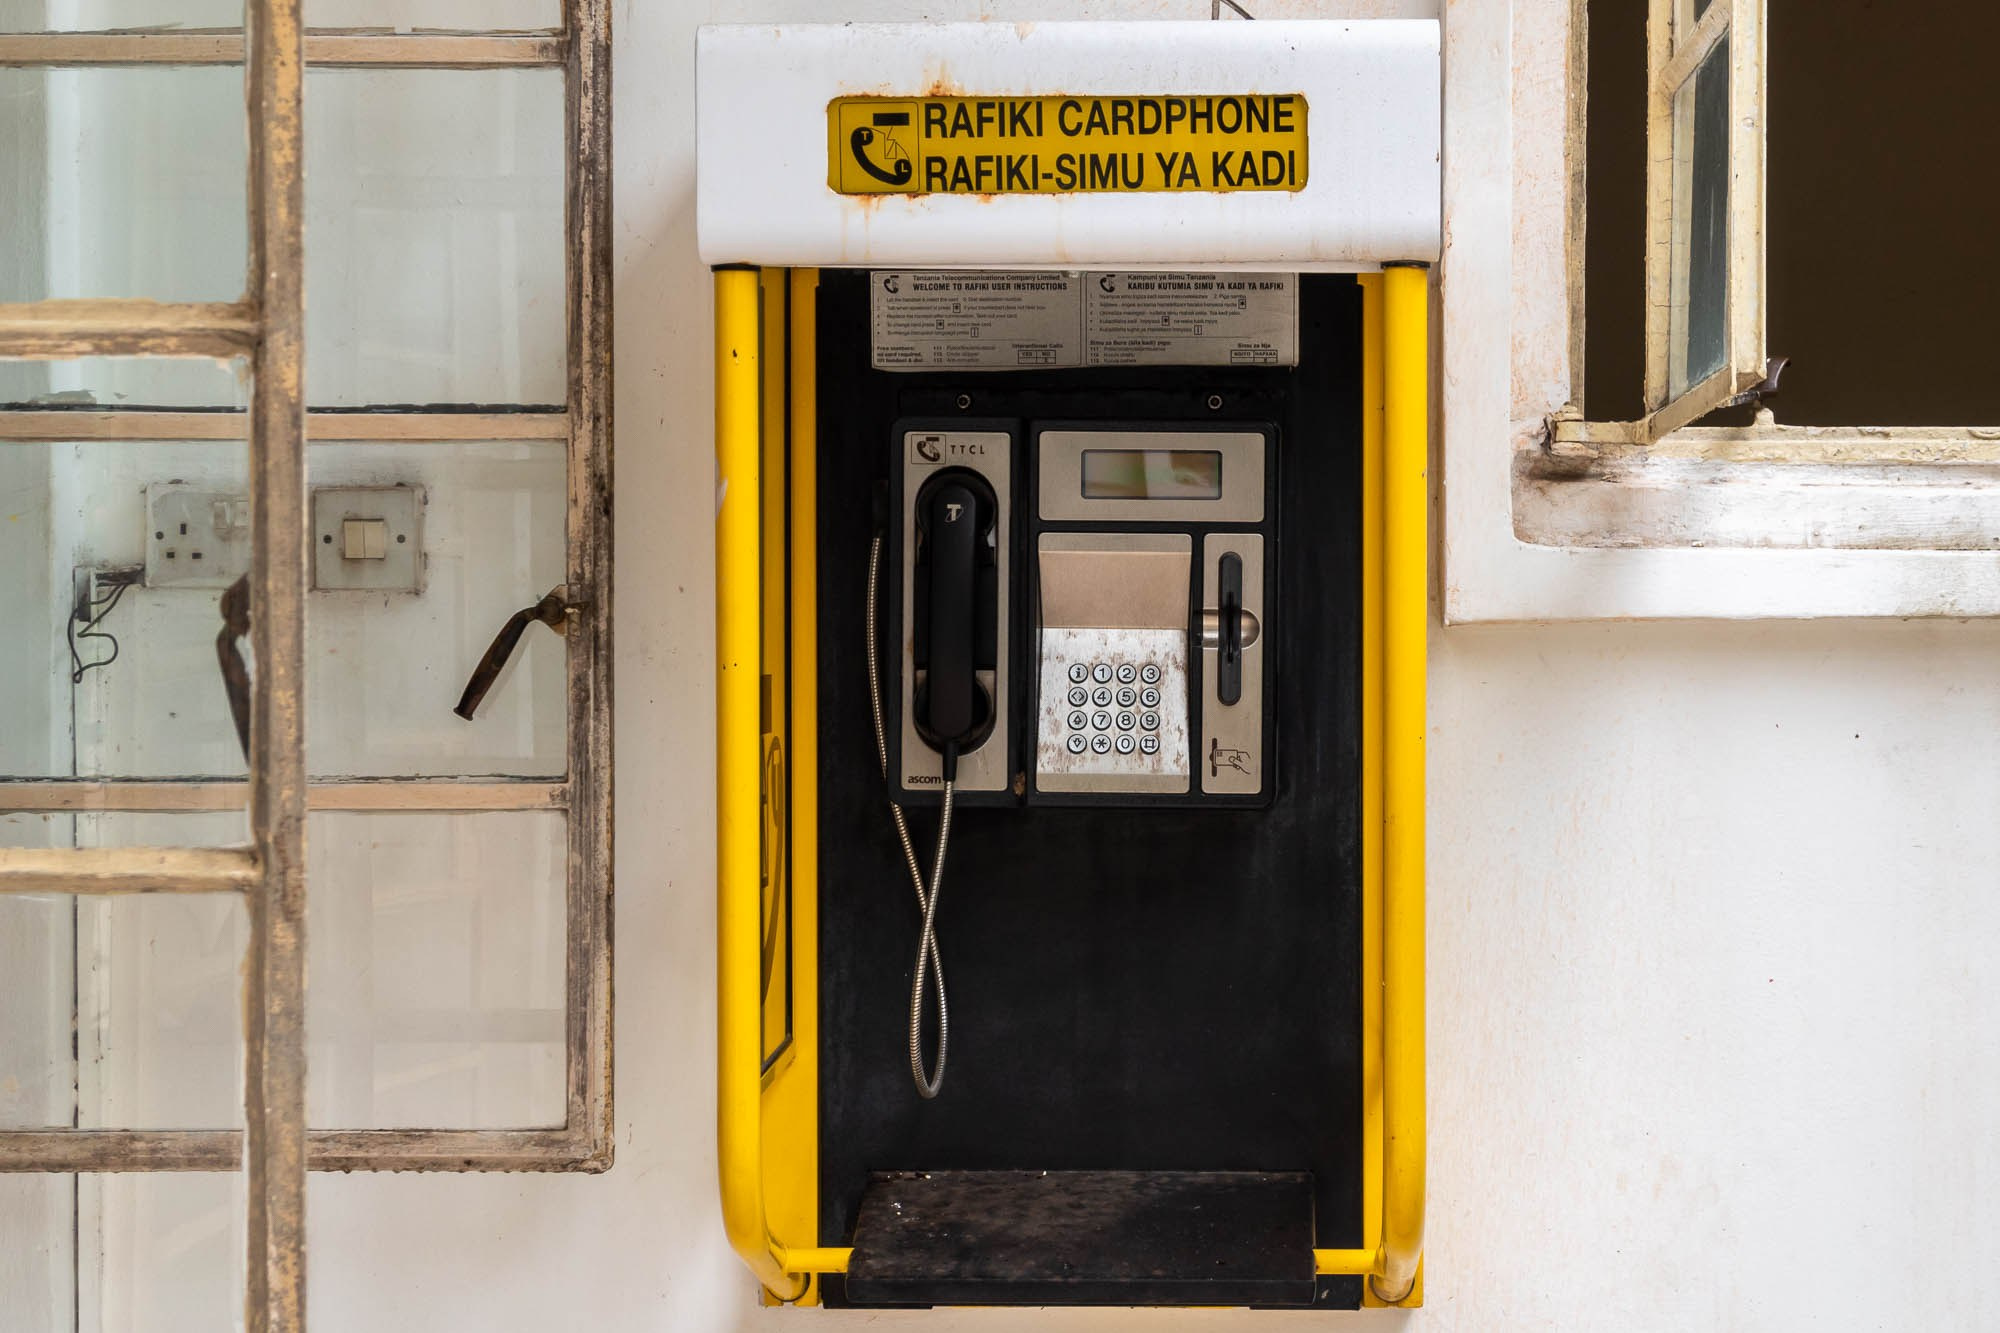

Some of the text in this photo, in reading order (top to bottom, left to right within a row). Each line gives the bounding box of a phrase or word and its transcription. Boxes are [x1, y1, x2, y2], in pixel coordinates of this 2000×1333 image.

[924, 97, 1295, 138] RAFIKI CARDPHONE
[925, 150, 1296, 191] RAFIKI-SIMU YA KADI
[913, 283, 950, 291] WELCOME
[1013, 282, 1068, 290] INSTRUCTIONS
[1127, 282, 1284, 290] KARIBU KUTUMIA SIMU YA KADI YA RAFIKI
[950, 444, 985, 455] TTCL
[1099, 667, 1105, 678] 1
[1122, 668, 1131, 679] 2
[1146, 668, 1155, 680] 3
[1097, 691, 1155, 702] 4 5 6
[1097, 714, 1155, 726] 7 8 9
[1121, 738, 1130, 749] 0
[907, 775, 942, 784] ascom
